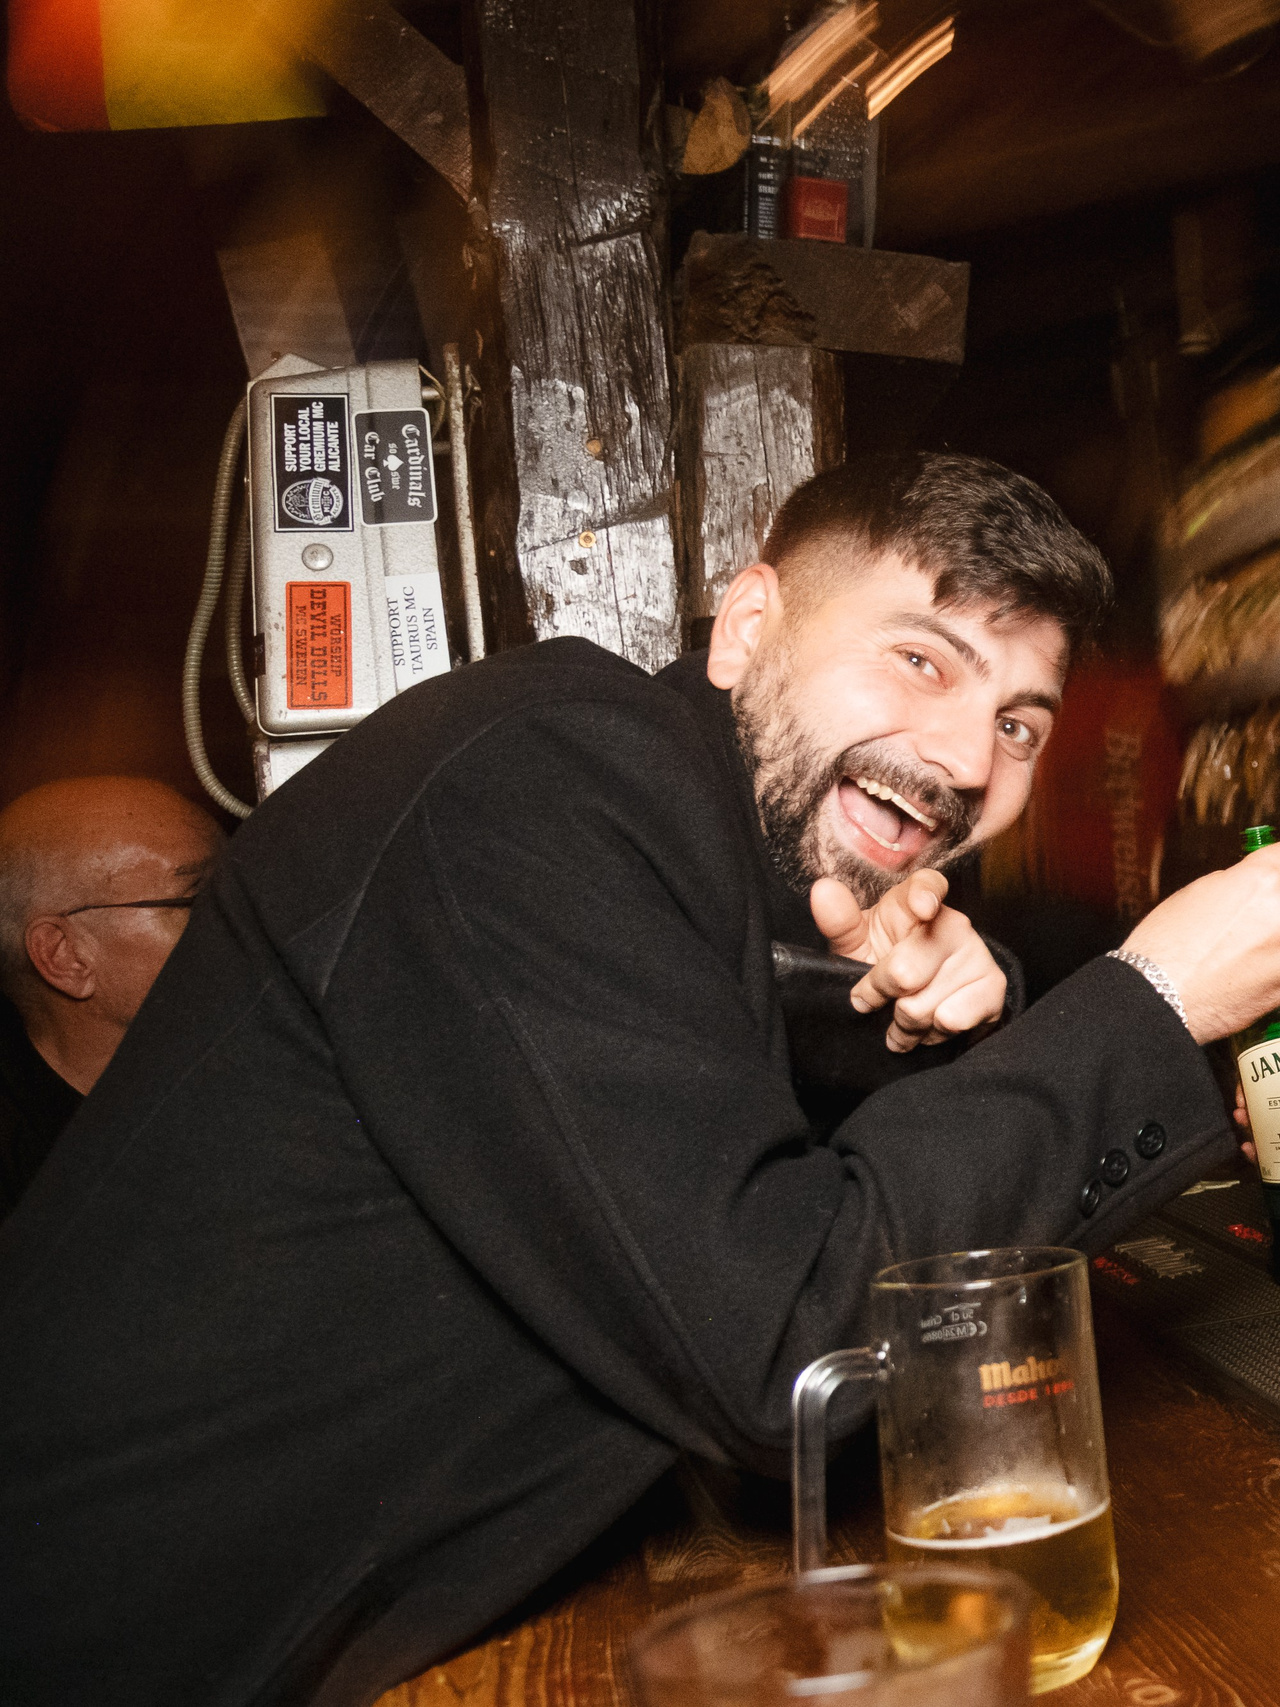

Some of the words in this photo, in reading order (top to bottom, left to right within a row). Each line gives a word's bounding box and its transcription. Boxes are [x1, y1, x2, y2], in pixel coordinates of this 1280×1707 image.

[298, 407, 310, 441] LOCAL
[312, 402, 324, 419] MC
[284, 423, 297, 472] SUPPORT
[299, 443, 312, 472] YOUR
[313, 421, 326, 472] GREMIUM
[328, 421, 340, 472] ALICANTE
[363, 431, 381, 460] Car
[402, 424, 428, 508] Cardinals
[311, 481, 324, 522] Gremium
[332, 488, 341, 515] ALICANTE
[364, 466, 386, 503] Club
[310, 588, 328, 641] DEVIL
[403, 586, 416, 610] MC
[330, 614, 343, 677] WORSHIP
[387, 597, 405, 666] SUPPORT
[406, 615, 423, 674] TAURUS
[422, 607, 438, 650] SPAIN
[296, 628, 308, 686] SWEDEN
[310, 646, 328, 701] DOLLS
[978, 1356, 1062, 1393] Maho
